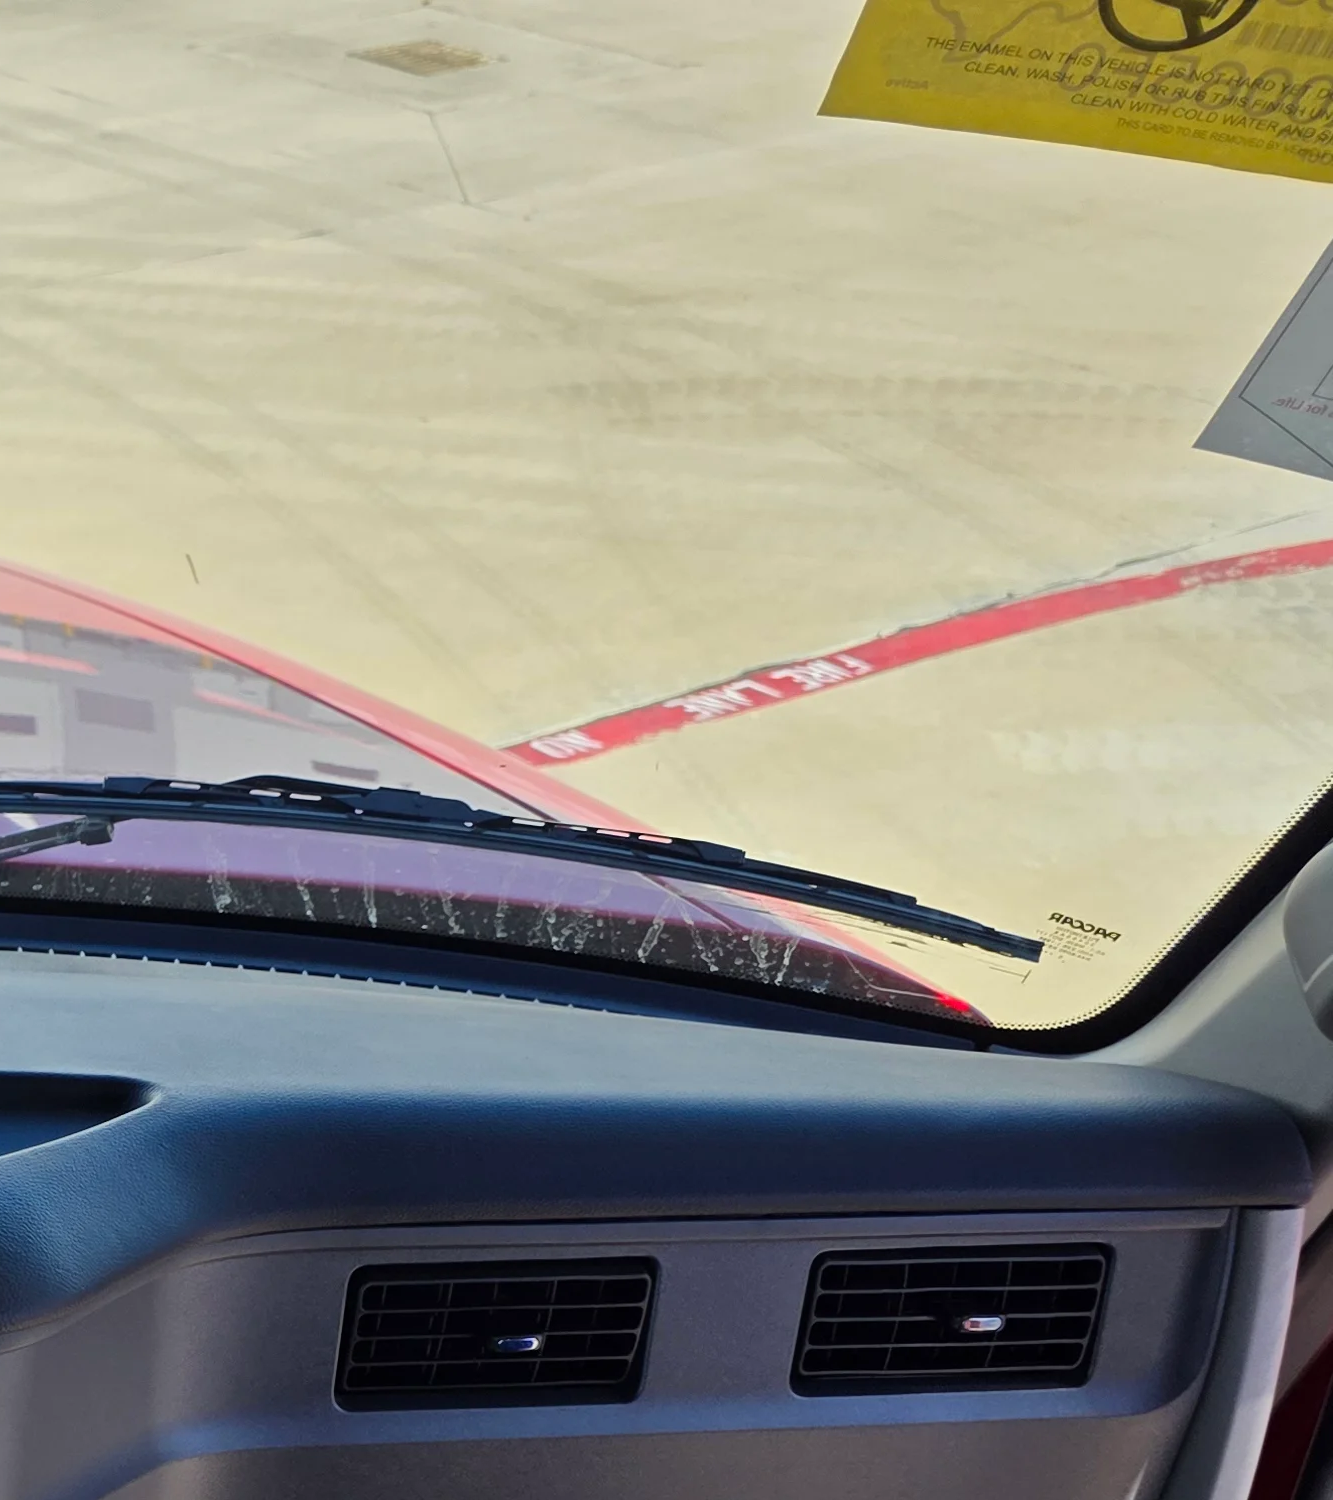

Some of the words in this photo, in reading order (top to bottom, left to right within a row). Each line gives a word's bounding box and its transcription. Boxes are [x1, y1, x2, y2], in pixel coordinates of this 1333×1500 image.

[926, 37, 956, 50] THE
[959, 41, 1023, 58] ENAMEL
[1028, 50, 1052, 61] ON
[1057, 52, 1094, 67] THIS
[1099, 56, 1166, 75] VEHICLE
[1169, 66, 1186, 79] IS
[1190, 69, 1228, 85] NOT
[1230, 73, 1275, 91] HARD
[1070, 93, 1126, 110] CLEAN
[1129, 100, 1168, 115] WITH
[1172, 107, 1218, 123] COLD
[1222, 115, 1280, 132] WATER
[1081, 75, 1140, 91] POLISH
[1145, 84, 1168, 96] OR
[1172, 88, 1206, 101] RUB
[1213, 92, 1247, 106] THIS
[1252, 100, 1305, 117] FINISH
[770, 652, 874, 692] FIRE
[662, 677, 784, 722] LANE
